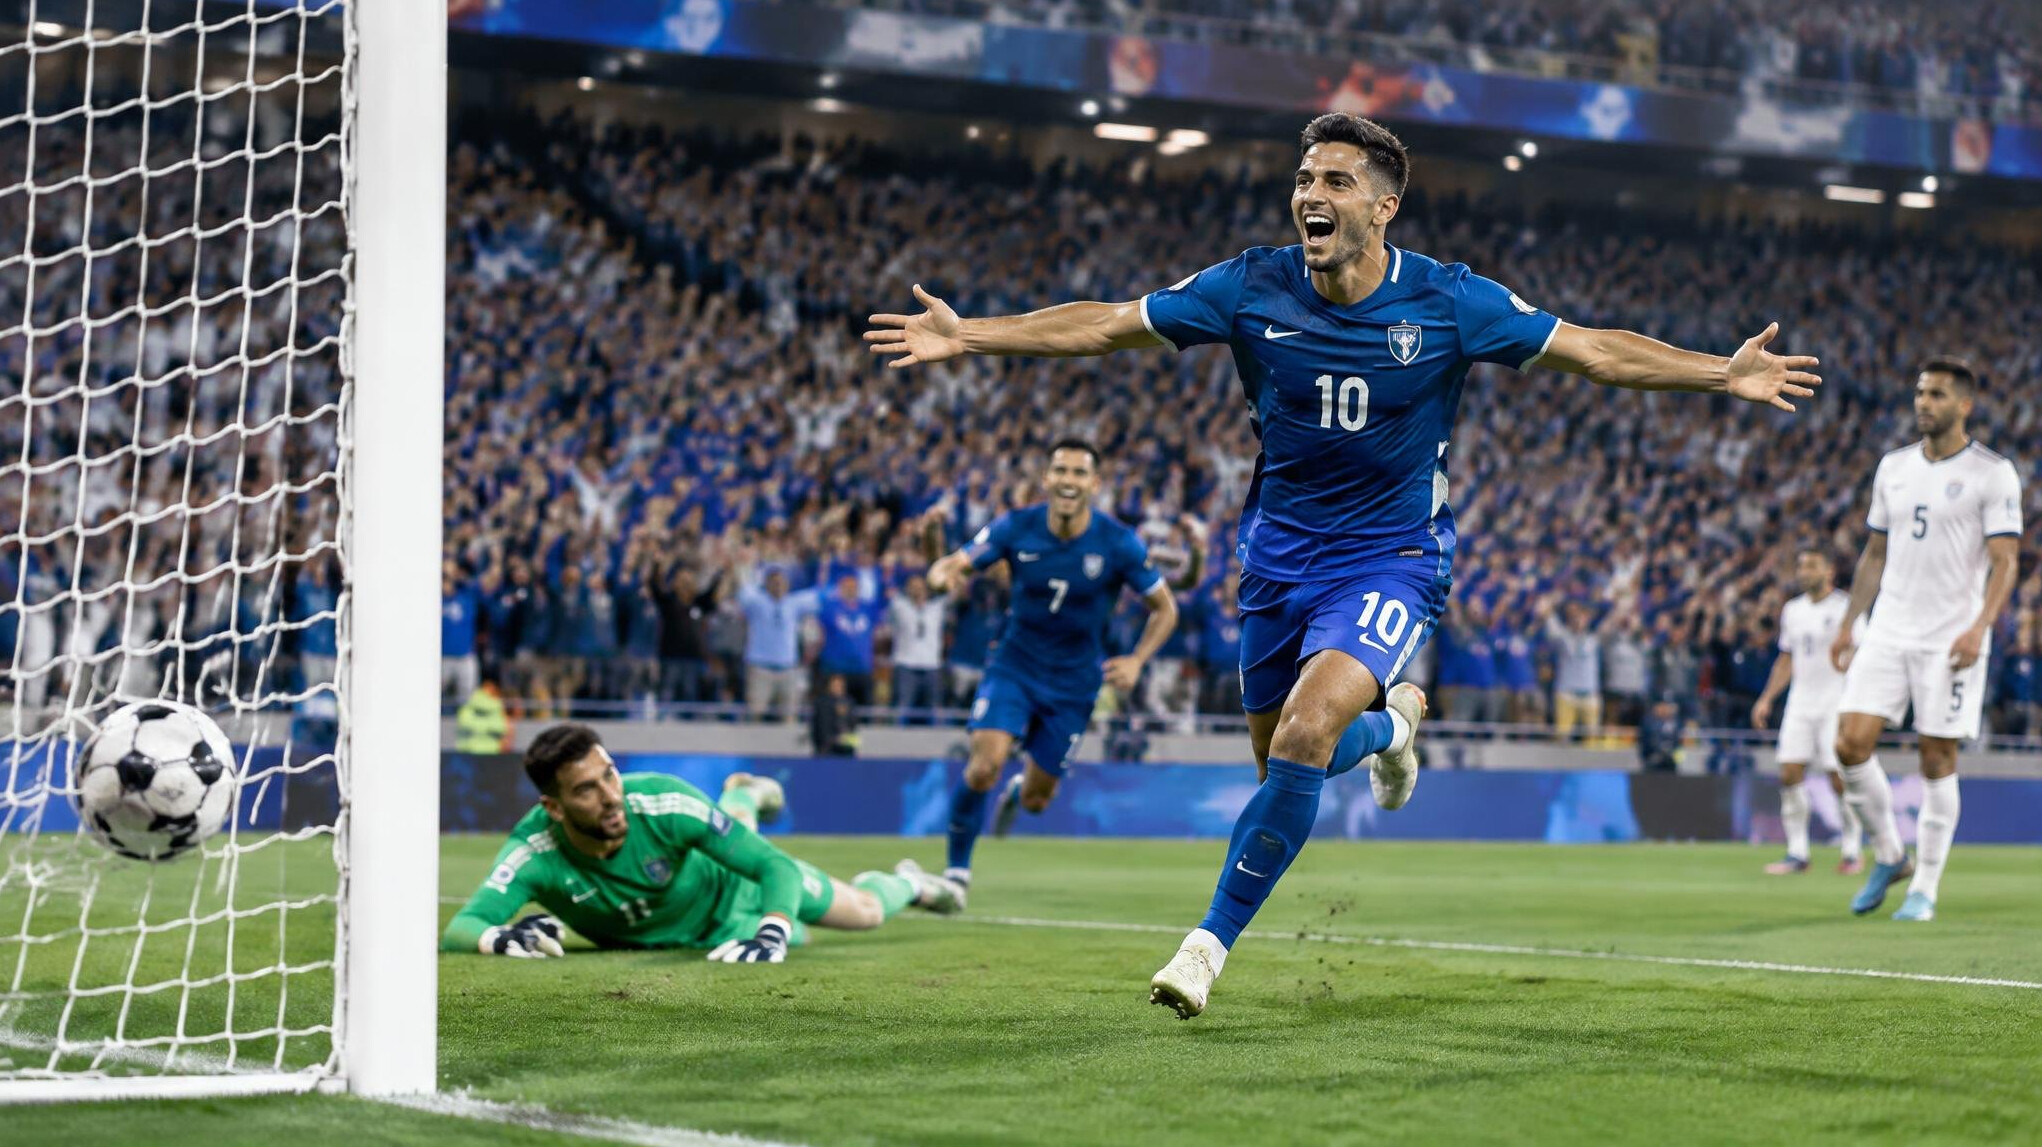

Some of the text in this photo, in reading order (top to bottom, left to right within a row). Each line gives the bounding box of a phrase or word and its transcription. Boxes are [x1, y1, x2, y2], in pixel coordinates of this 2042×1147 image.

[1315, 374, 1369, 431] 10
[1912, 503, 1928, 540] 5
[1048, 577, 1069, 614] 7
[1356, 591, 1409, 647] 10
[1951, 680, 1964, 711] 5
